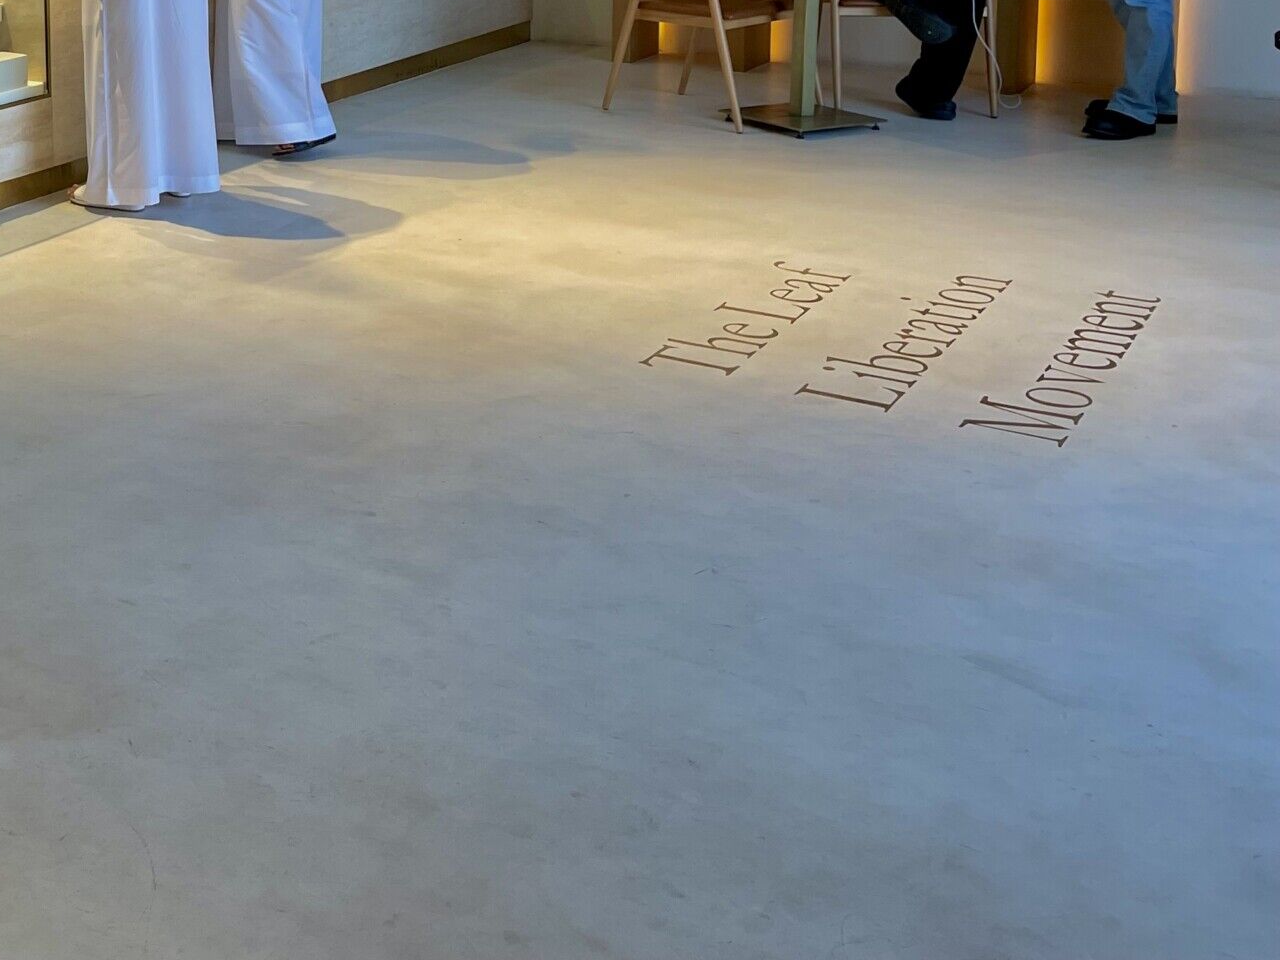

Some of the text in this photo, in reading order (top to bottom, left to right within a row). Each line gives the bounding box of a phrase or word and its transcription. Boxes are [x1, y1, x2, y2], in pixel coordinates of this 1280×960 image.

[638, 260, 852, 377] The Leaf
[793, 274, 1014, 414] Liberation
[957, 289, 1162, 449] Movement
